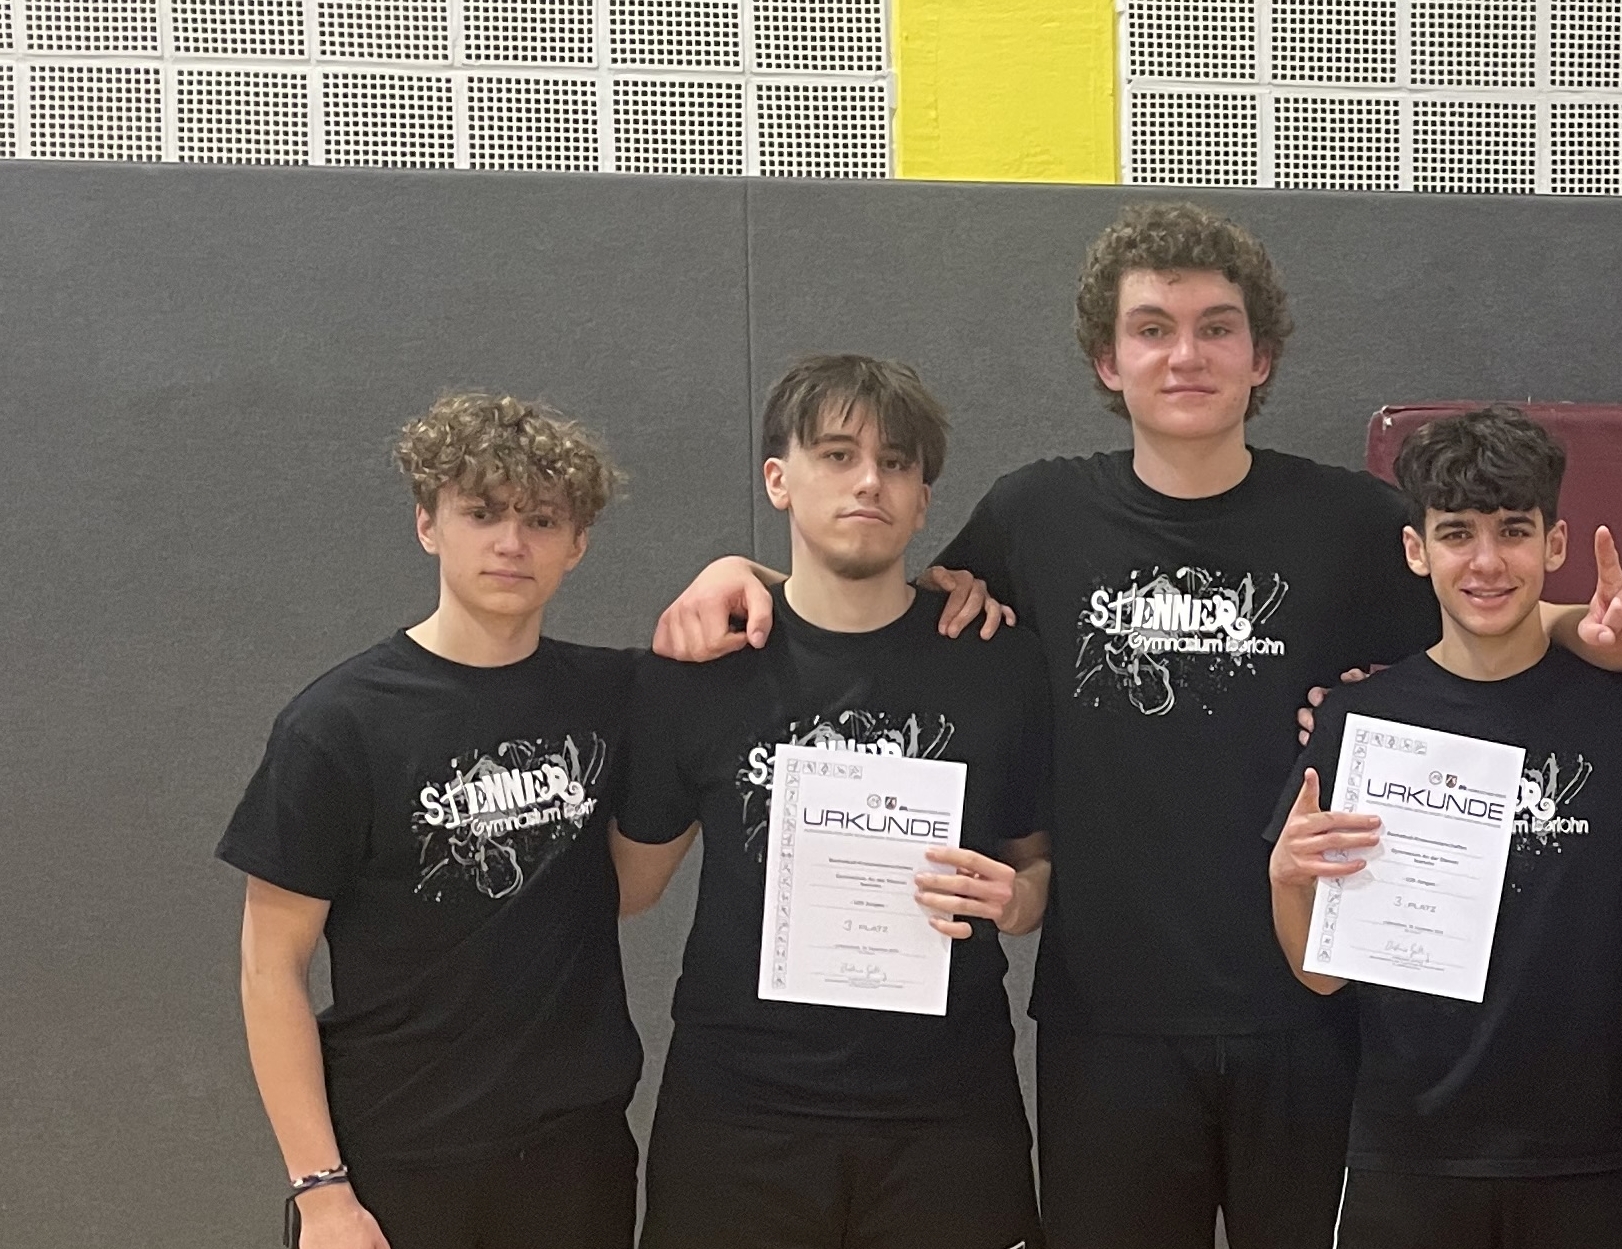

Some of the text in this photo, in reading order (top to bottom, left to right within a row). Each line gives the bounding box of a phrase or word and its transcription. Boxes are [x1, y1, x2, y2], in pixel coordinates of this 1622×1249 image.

[1090, 585, 1252, 640] STENNER
[1128, 632, 1223, 654] Gymnasium
[420, 764, 585, 830] STENNER
[1366, 778, 1505, 822] URKUNDE
[803, 808, 950, 839] URKUNDE
